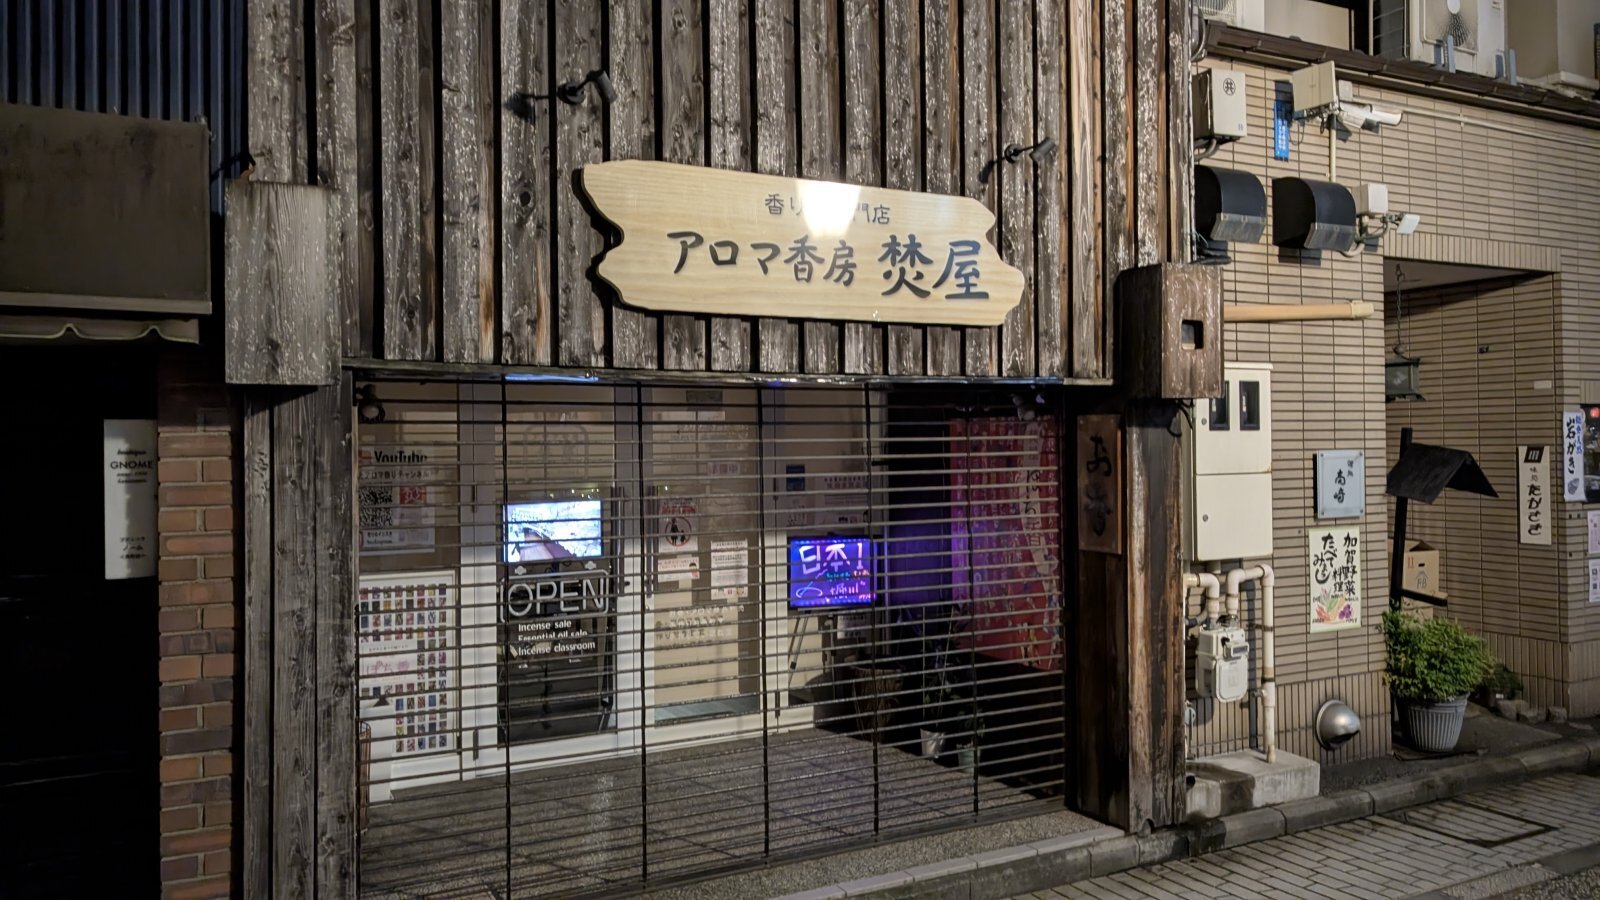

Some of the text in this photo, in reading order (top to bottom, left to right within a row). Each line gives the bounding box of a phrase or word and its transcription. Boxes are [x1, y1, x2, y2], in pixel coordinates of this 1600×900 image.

[765, 194, 891, 225] 香り門店
[666, 231, 990, 300] アロマ香房 焚屋
[1566, 417, 1576, 475] 岩がき
[110, 461, 152, 470] GNOME
[1321, 532, 1337, 568] たべて
[1342, 532, 1358, 596] 加賀野菜
[508, 578, 604, 617] OPEN
[518, 620, 572, 632] Incense sale
[518, 631, 556, 641] Essential
[518, 641, 596, 656] Incense classroom
